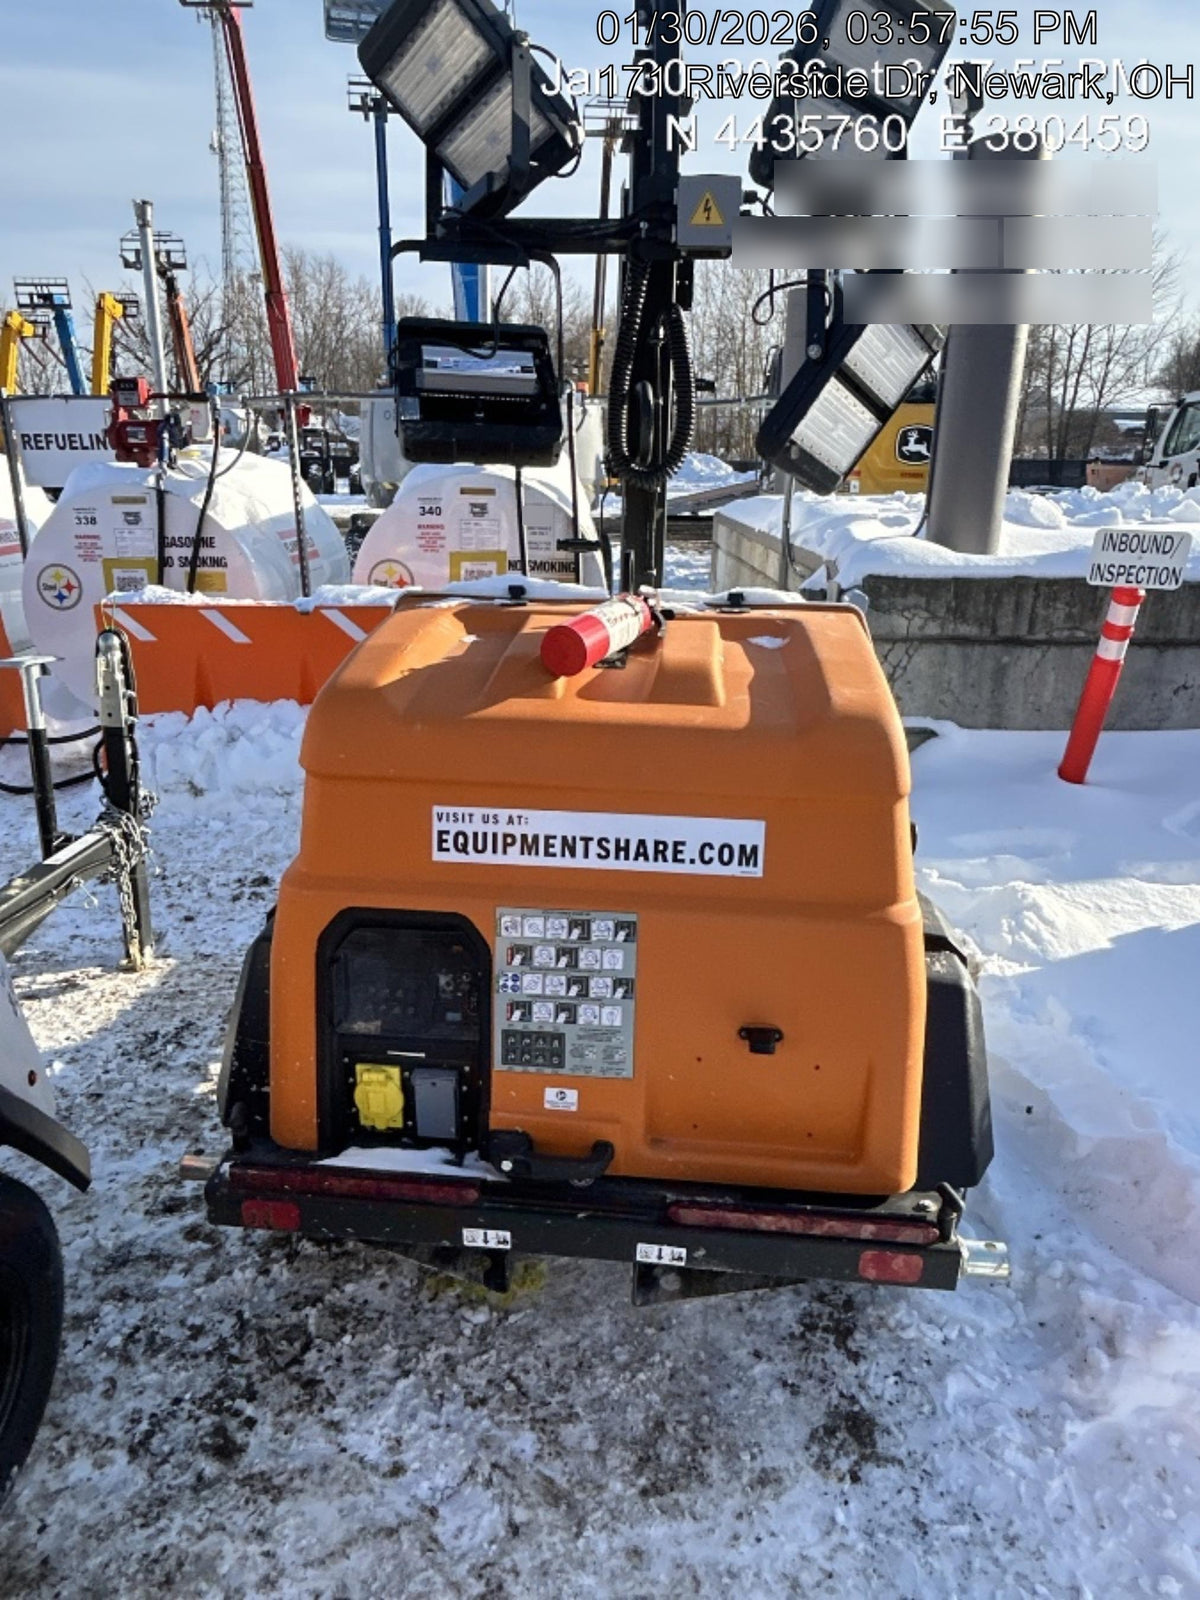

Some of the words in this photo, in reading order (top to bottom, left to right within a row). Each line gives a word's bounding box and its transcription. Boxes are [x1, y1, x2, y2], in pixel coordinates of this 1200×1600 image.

[21, 433, 115, 451] REFUELIN
[419, 506, 442, 516] 340
[74, 515, 97, 526] 338
[162, 536, 216, 548] GASONE
[1102, 532, 1185, 559] INBOUND/
[528, 560, 576, 573] SMOKING
[1089, 562, 1184, 586] INSPECTION
[436, 811, 475, 825] VISIT
[481, 813, 501, 826] US
[507, 813, 530, 826] AT:
[436, 829, 760, 868] EQUIPMENTSHARE.COM
